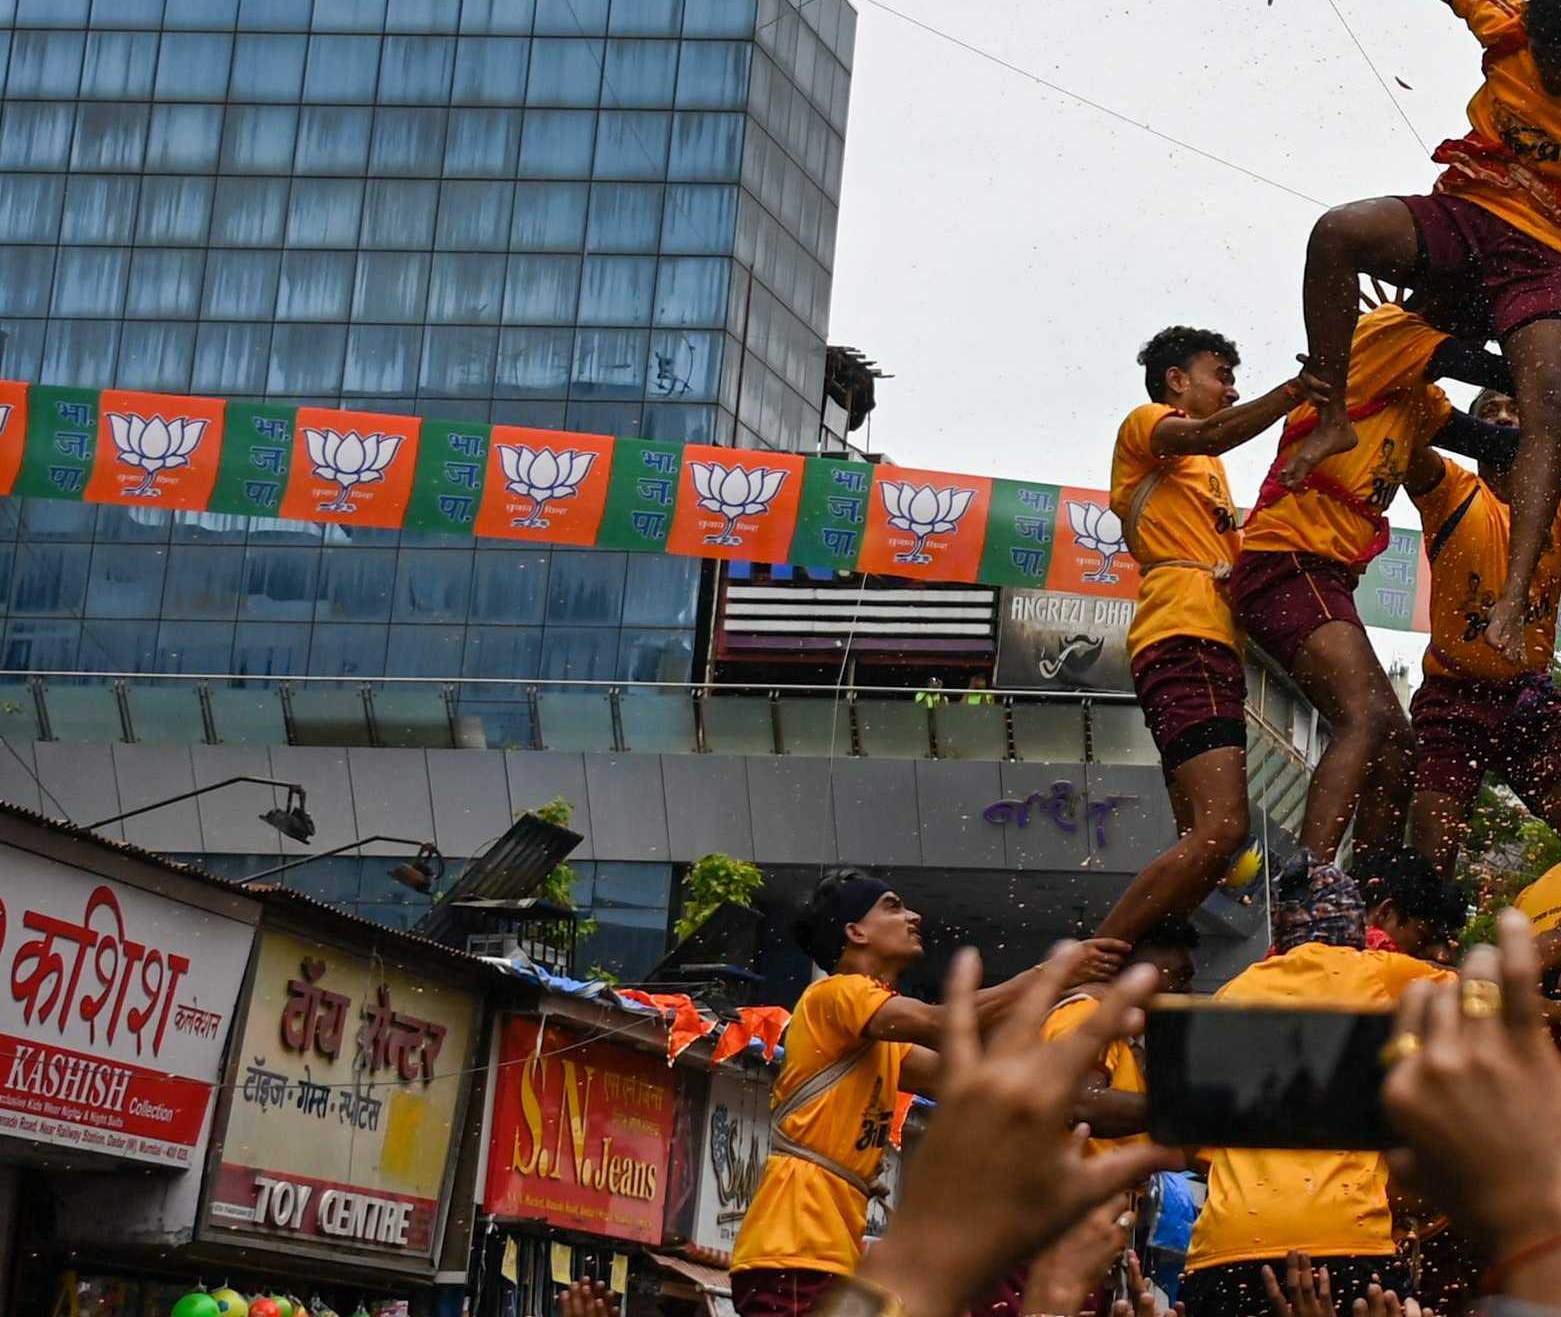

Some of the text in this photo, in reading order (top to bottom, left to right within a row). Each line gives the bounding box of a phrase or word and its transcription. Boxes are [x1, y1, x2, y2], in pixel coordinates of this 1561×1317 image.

[56, 400, 96, 426] भा.
[253, 416, 292, 442] भा.
[56, 432, 93, 460] ज.
[448, 433, 485, 457] भा.
[251, 445, 287, 476] ज.
[641, 450, 678, 474] भा.
[49, 465, 82, 491] पा.
[445, 461, 480, 490] ज.
[831, 468, 869, 493] भा.
[246, 480, 279, 507] पा.
[637, 477, 673, 506] ज.
[1017, 488, 1055, 512] भा.
[439, 494, 473, 523] पा.
[827, 496, 864, 524] ज.
[632, 510, 666, 539] पा.
[1014, 515, 1050, 543] ज.
[822, 528, 857, 557] पा.
[1009, 546, 1044, 577] पा.
[1378, 557, 1414, 585] ज.
[1011, 595, 1137, 626] ANGREZI DHA
[1376, 588, 1410, 619] पा.
[11, 885, 222, 1058] कशिश कलेक्शन
[281, 955, 351, 1063] टॉय
[5, 1045, 173, 1124] KASHISH Collection
[297, 1065, 331, 1118] गेम्स
[56, 1124, 82, 1143] Railway
[513, 1049, 595, 1187] S.N.
[595, 1136, 657, 1201] Jeans
[254, 1176, 415, 1245] TOY CENTRE
